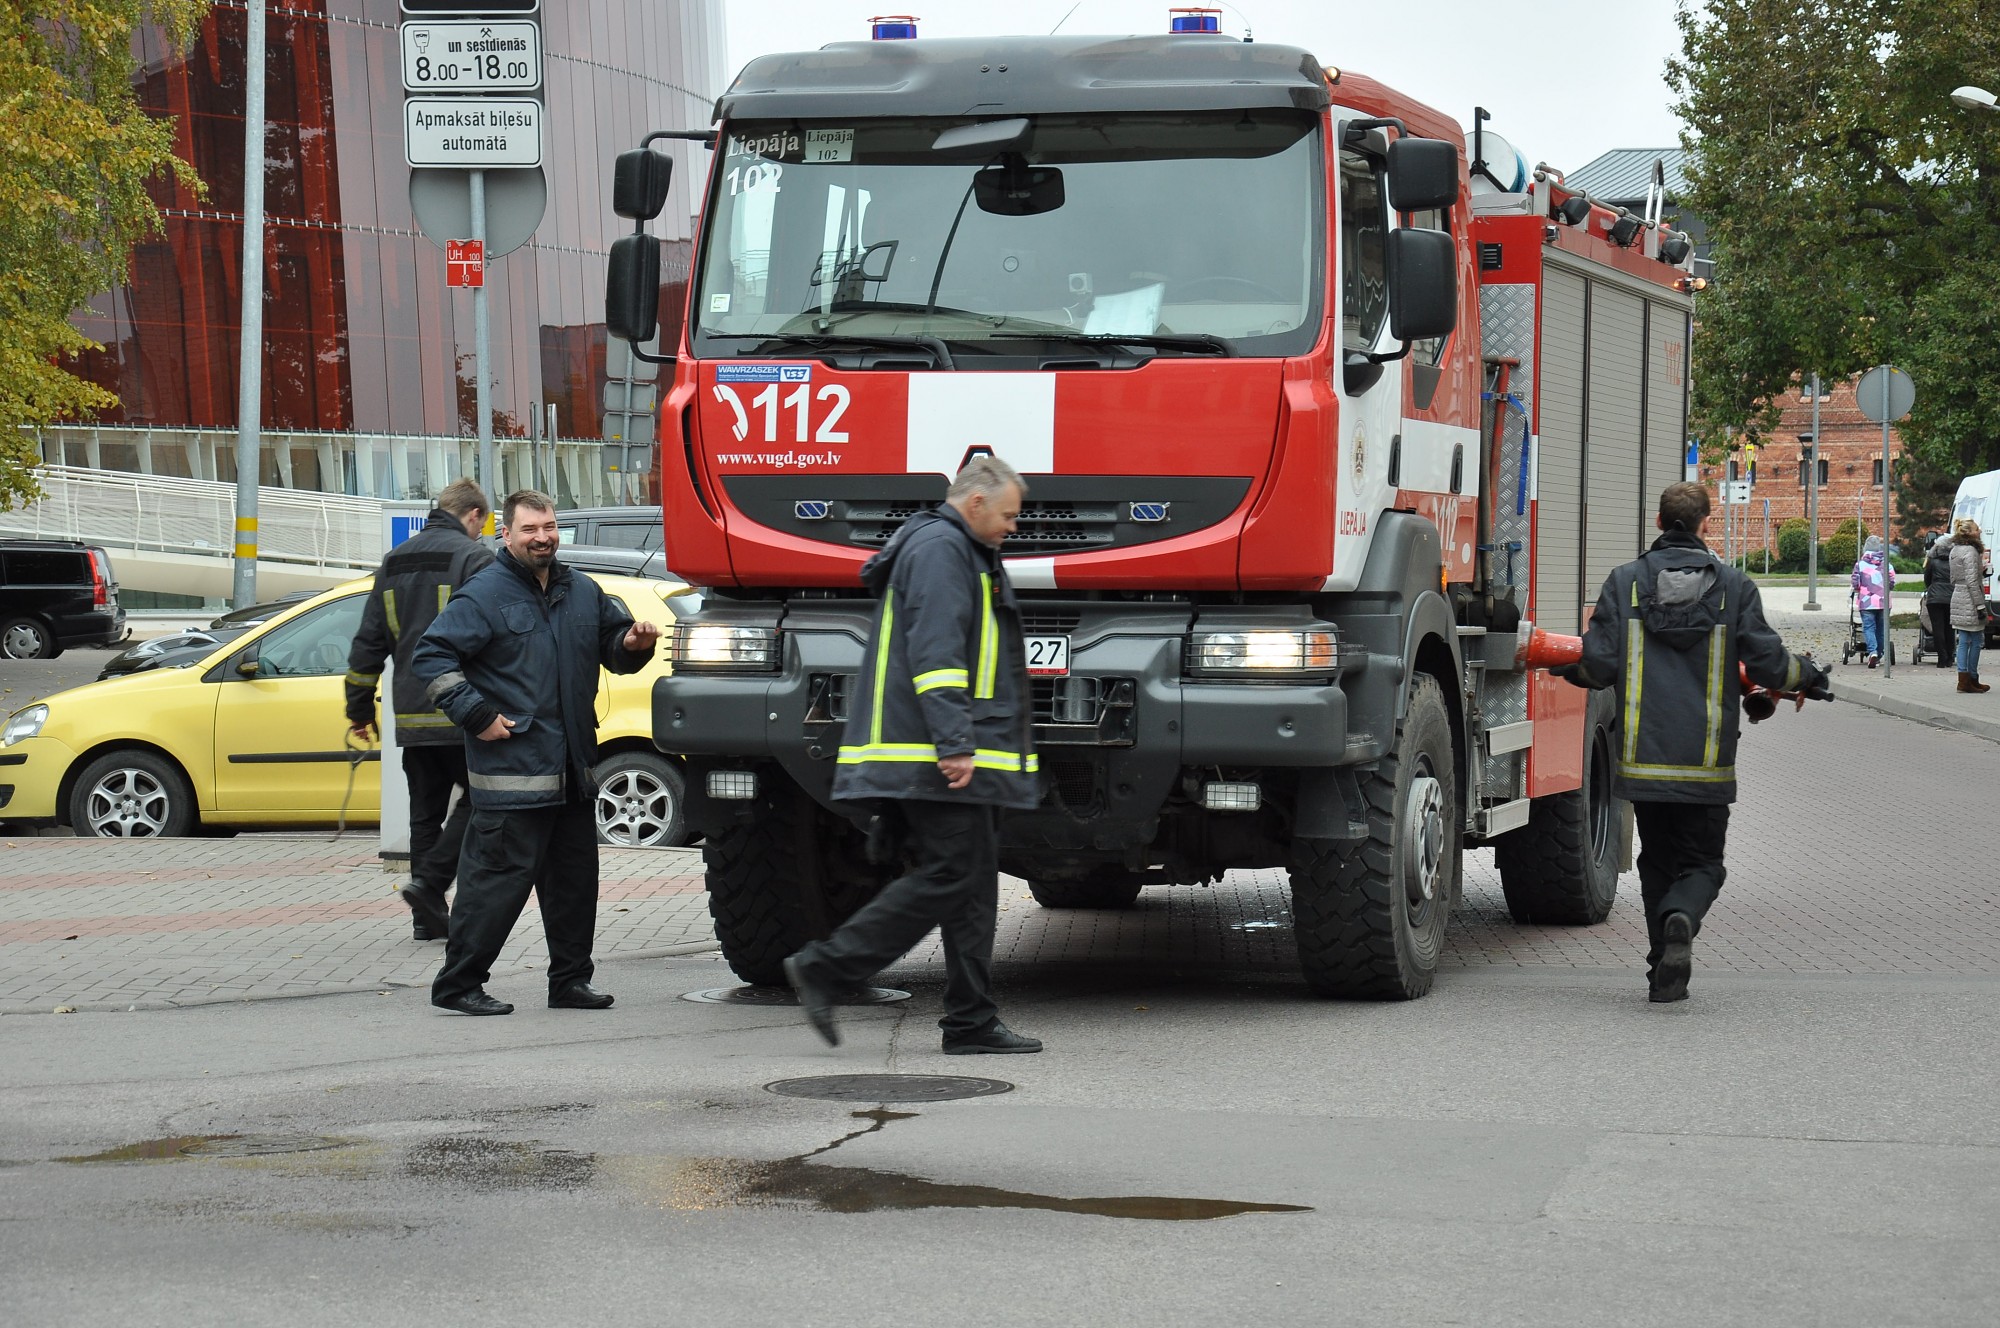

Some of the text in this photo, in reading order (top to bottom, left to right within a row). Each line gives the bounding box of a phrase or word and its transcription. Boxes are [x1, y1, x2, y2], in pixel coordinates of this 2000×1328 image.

[448, 37, 527, 53] un sestdienās
[415, 110, 532, 131] Apmaksāt biļešu
[442, 135, 507, 150] automātā
[806, 130, 854, 144] Liepāja
[727, 130, 800, 161] Liepāja
[817, 149, 839, 161] 102
[727, 163, 784, 196] 102
[448, 249, 463, 260] UH
[469, 252, 480, 261] 100
[462, 274, 470, 283] 10
[718, 366, 779, 374] WAWRZASZEK
[752, 383, 851, 444] 112
[716, 450, 842, 468] www.vugd.gov.lv
[1439, 497, 1458, 551] 112
[1029, 640, 1062, 665] 27
